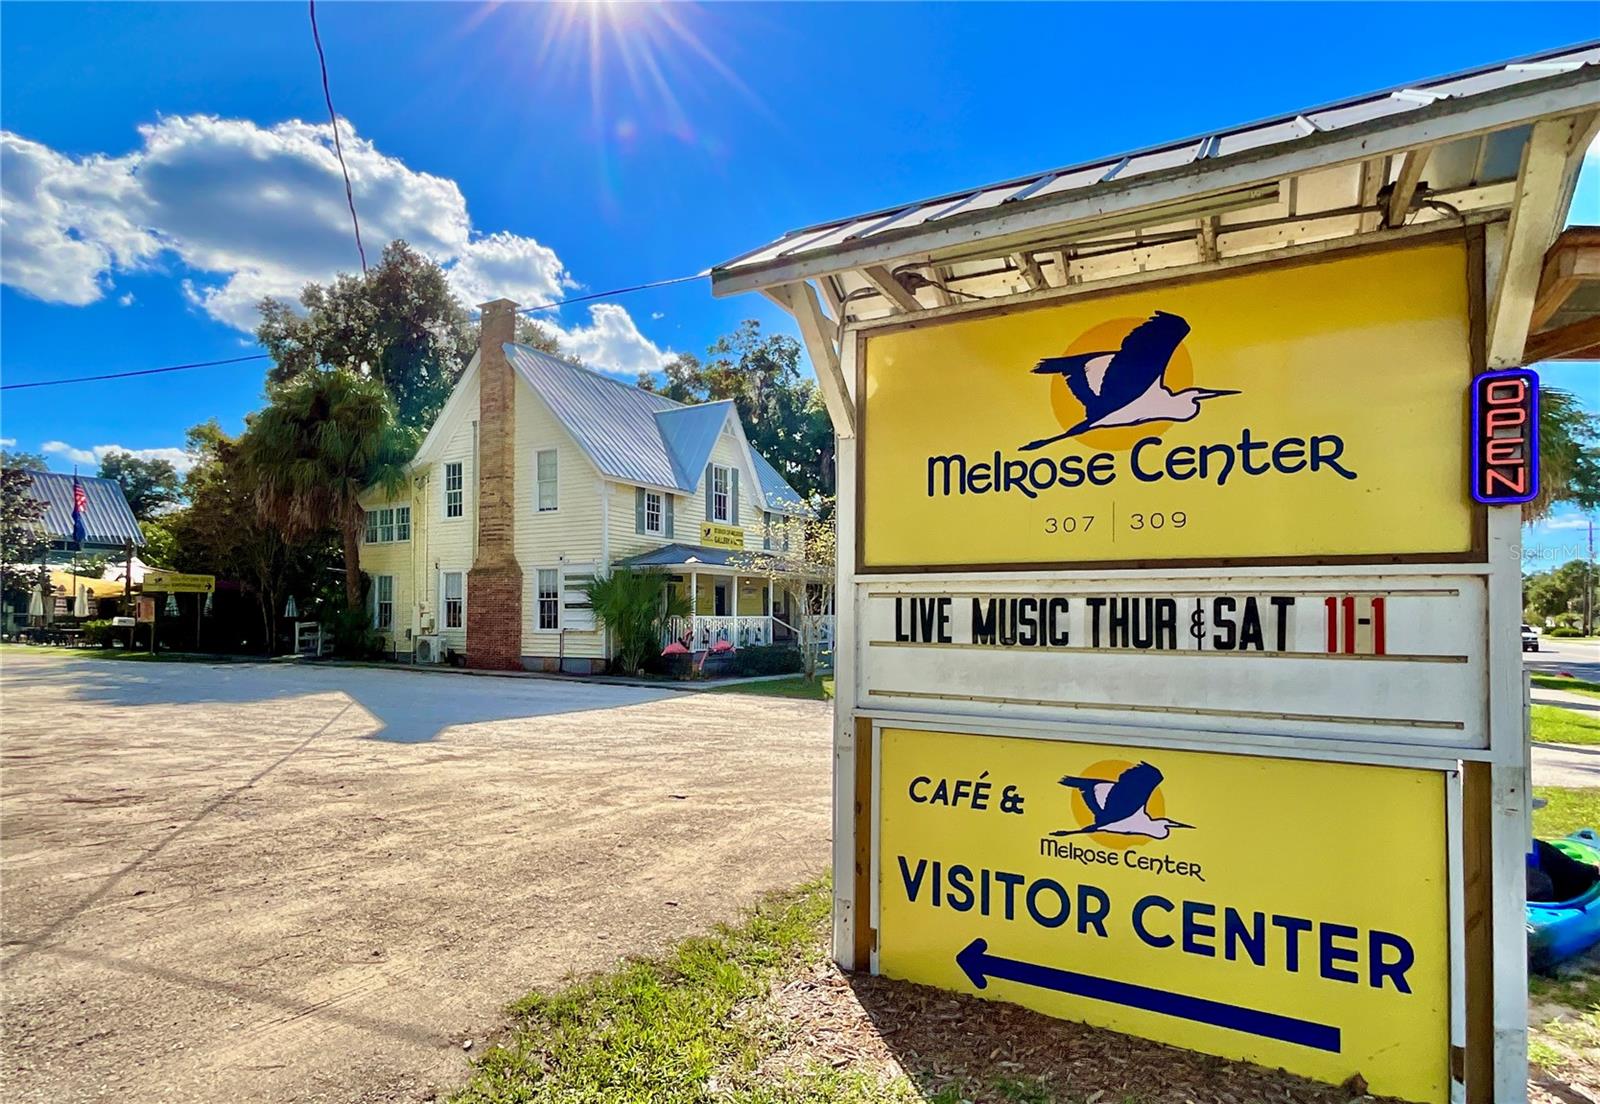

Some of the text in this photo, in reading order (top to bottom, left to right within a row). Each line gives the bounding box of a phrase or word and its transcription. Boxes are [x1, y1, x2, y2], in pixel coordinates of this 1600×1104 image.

[928, 428, 1358, 498] Melrose Center
[1486, 379, 1526, 495] OPEN
[1044, 511, 1187, 534] 307 309
[895, 596, 1386, 656] LIVE MUSIC THUR & SAT 11-1
[909, 770, 1025, 815] CAFÉ &
[1040, 838, 1206, 883] Melrose Center
[897, 855, 1416, 995] VISITOR CENTER
